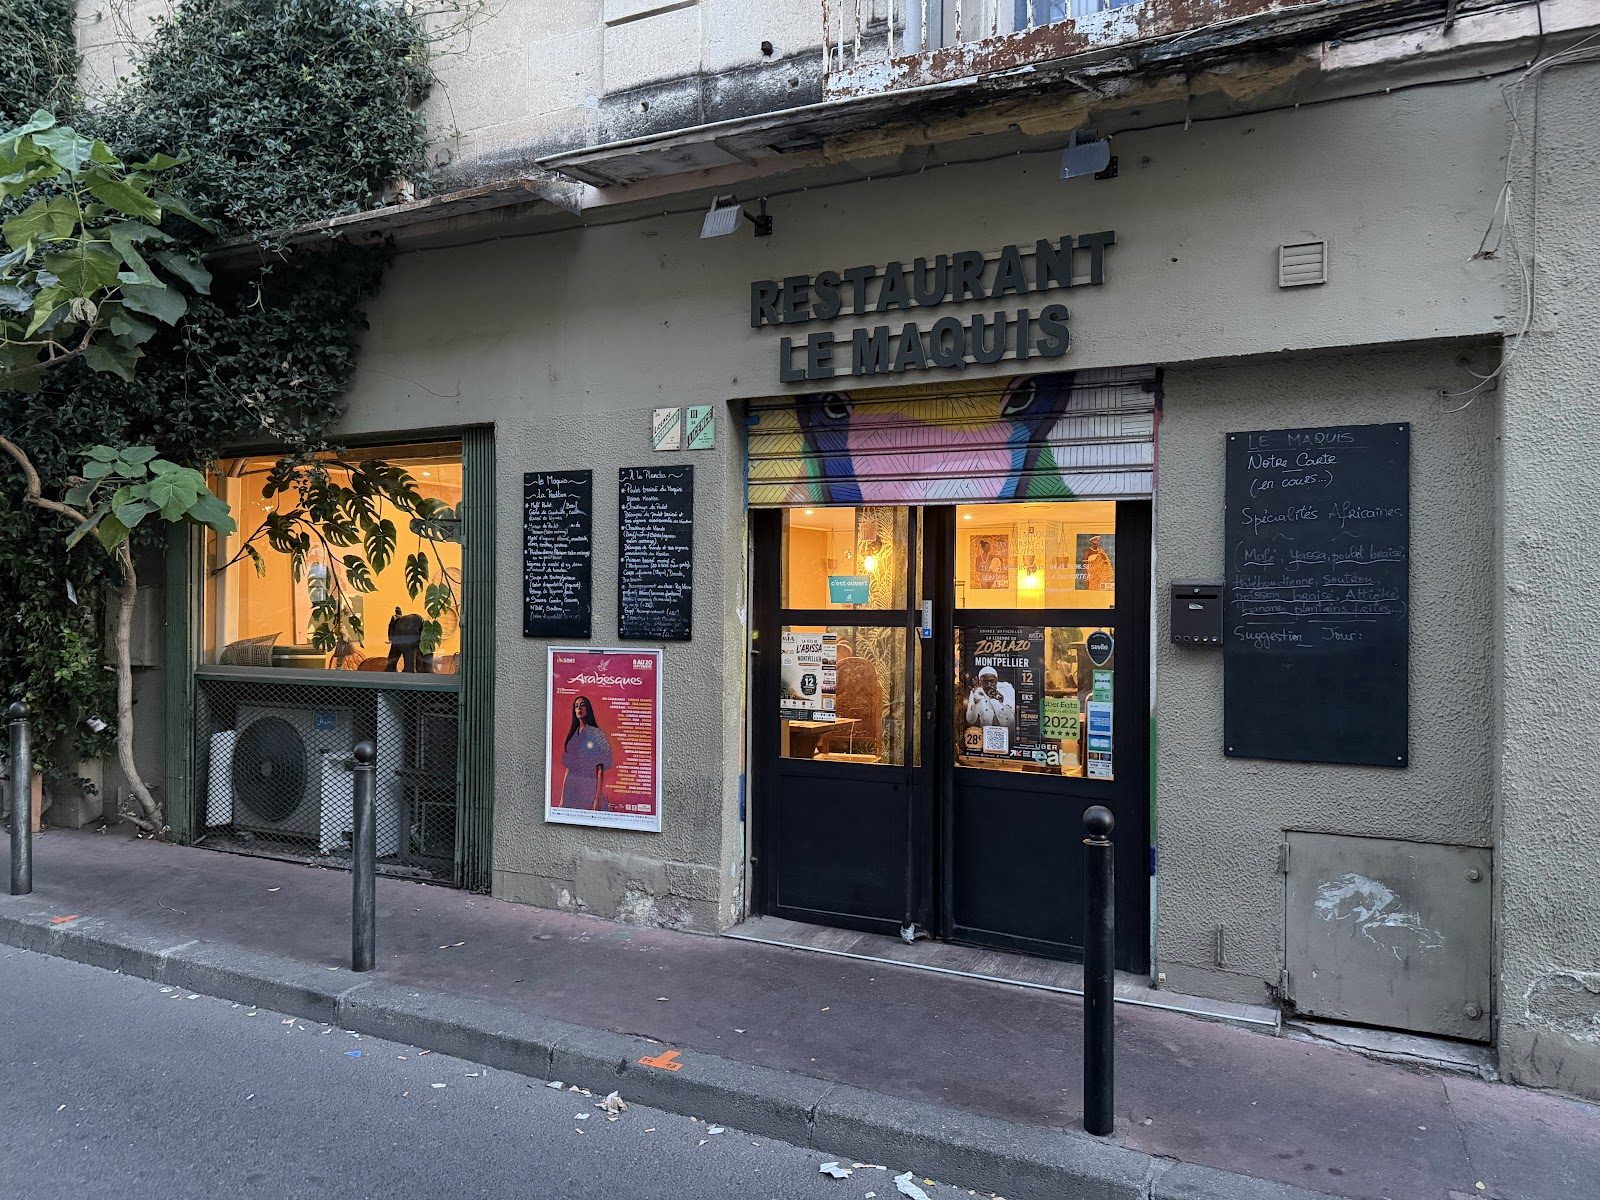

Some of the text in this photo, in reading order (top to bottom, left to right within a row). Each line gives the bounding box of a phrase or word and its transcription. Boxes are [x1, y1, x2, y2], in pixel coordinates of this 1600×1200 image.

[751, 230, 1116, 328] RESTAURANT
[780, 303, 1071, 383] LE MAQUIS
[687, 409, 713, 446] LICENCE
[1247, 434, 1271, 450] LE
[1247, 452, 1338, 470] Notre Carte
[1249, 469, 1334, 499] (en cours...)
[1241, 505, 1319, 536] Spécialités
[1233, 626, 1304, 650] Suggestion
[796, 644, 823, 654] L'ABISSA
[974, 639, 1031, 656] ZOBLAZO
[975, 656, 1029, 668] MONTPELLIER
[567, 671, 644, 690] Arabesques
[805, 677, 814, 687] 12
[1021, 672, 1034, 683] 12
[1043, 700, 1078, 709] Uber Eats
[1043, 715, 1078, 730] 2022
[1035, 743, 1058, 751] UBER
